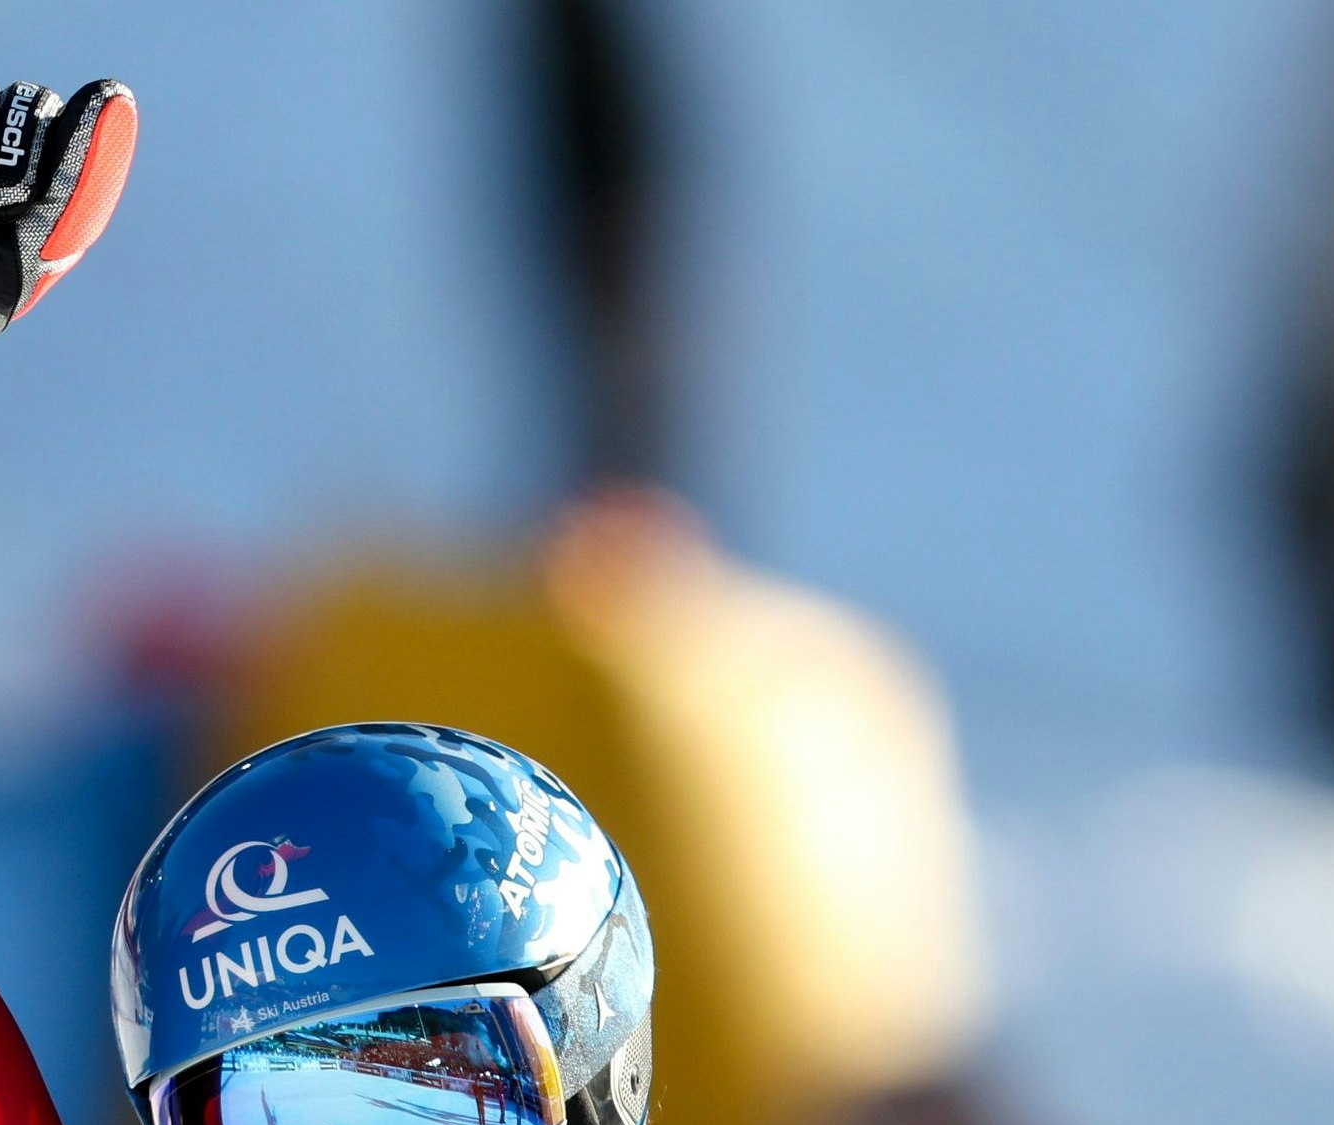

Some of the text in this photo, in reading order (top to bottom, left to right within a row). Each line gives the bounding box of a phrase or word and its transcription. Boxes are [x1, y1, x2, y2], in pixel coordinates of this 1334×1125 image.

[499, 779, 551, 921] ATOMIC
[179, 914, 374, 1010] UNIQA
[257, 991, 331, 1021] Ski Austria
